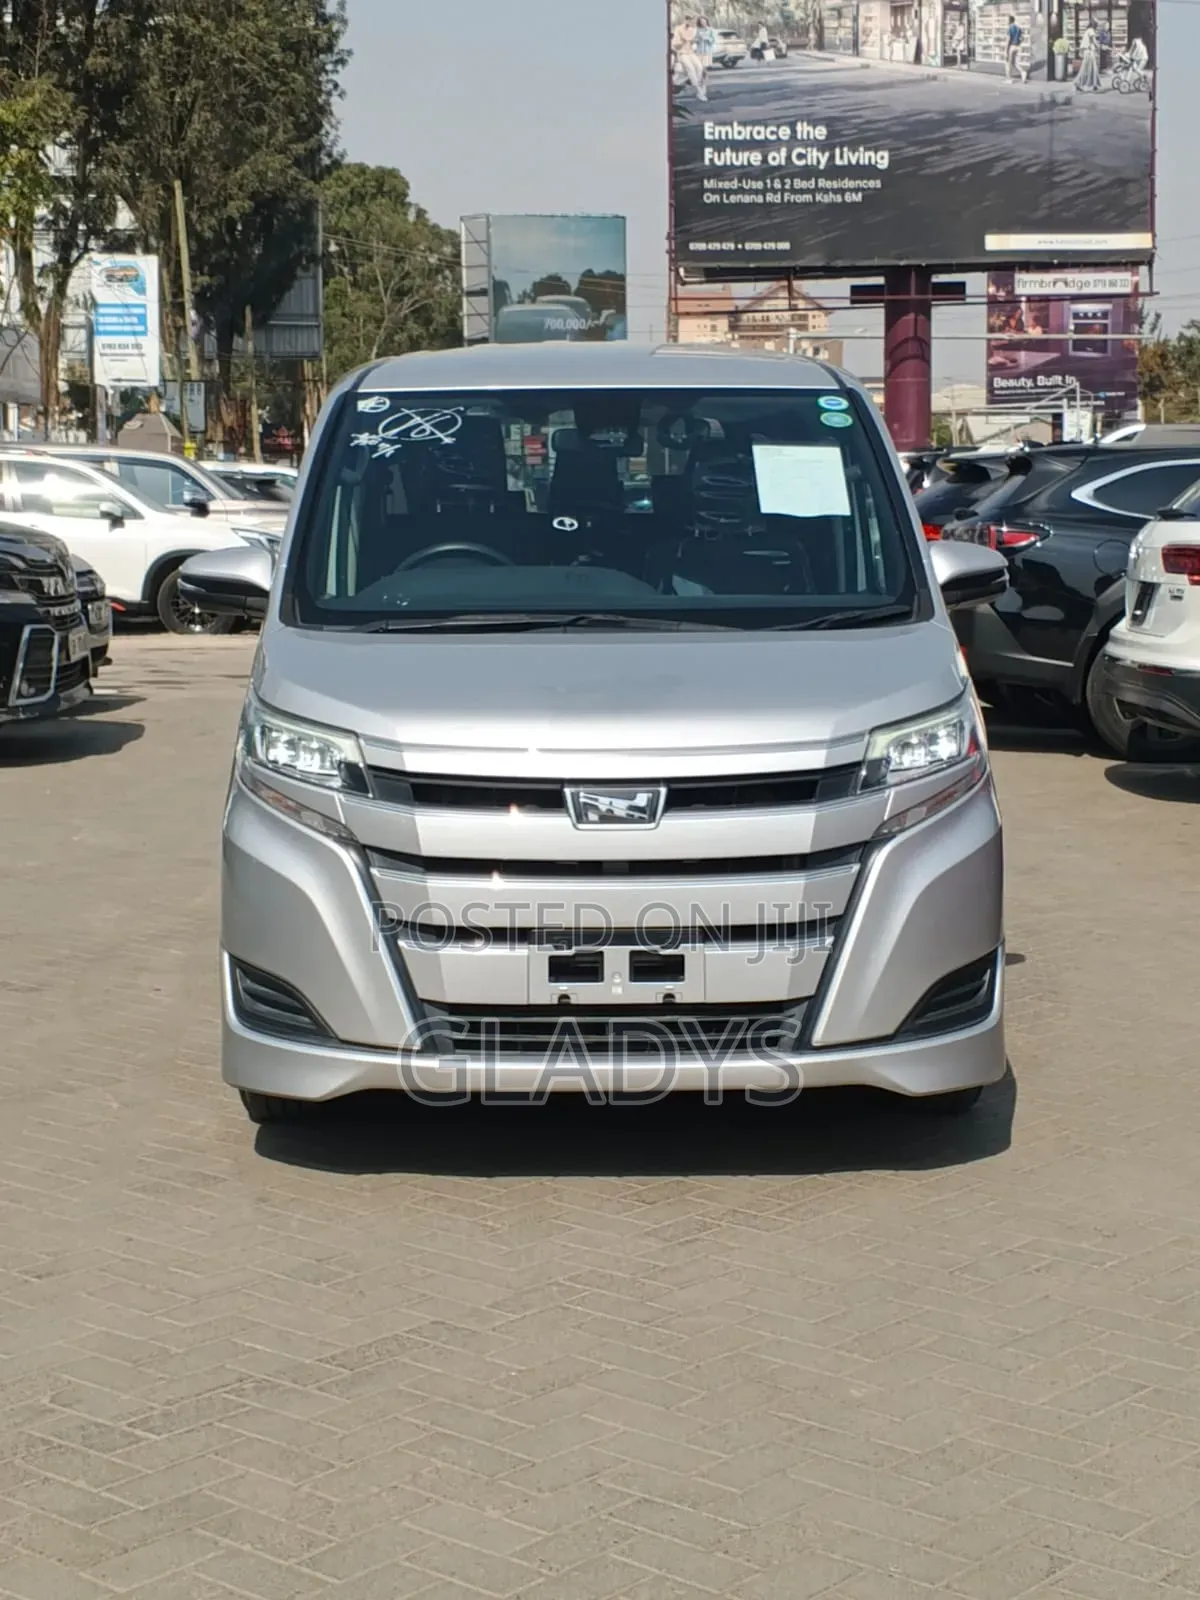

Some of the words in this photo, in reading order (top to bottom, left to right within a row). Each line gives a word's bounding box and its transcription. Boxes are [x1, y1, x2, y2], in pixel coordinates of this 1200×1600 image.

[703, 121, 790, 140] Embrace
[796, 121, 828, 140] the
[703, 148, 762, 166] Future
[767, 147, 787, 166] of
[791, 147, 829, 169] City
[834, 147, 890, 169] Living
[703, 179, 763, 190] Mixed-Use
[773, 179, 782, 189] &
[784, 179, 791, 189] 2
[793, 179, 815, 189] Bed
[817, 178, 882, 189] Residences
[703, 193, 720, 203] On
[723, 193, 764, 203] Lenana
[766, 193, 781, 203] Rd
[784, 193, 812, 203] From
[1036, 374, 1062, 386] Built
